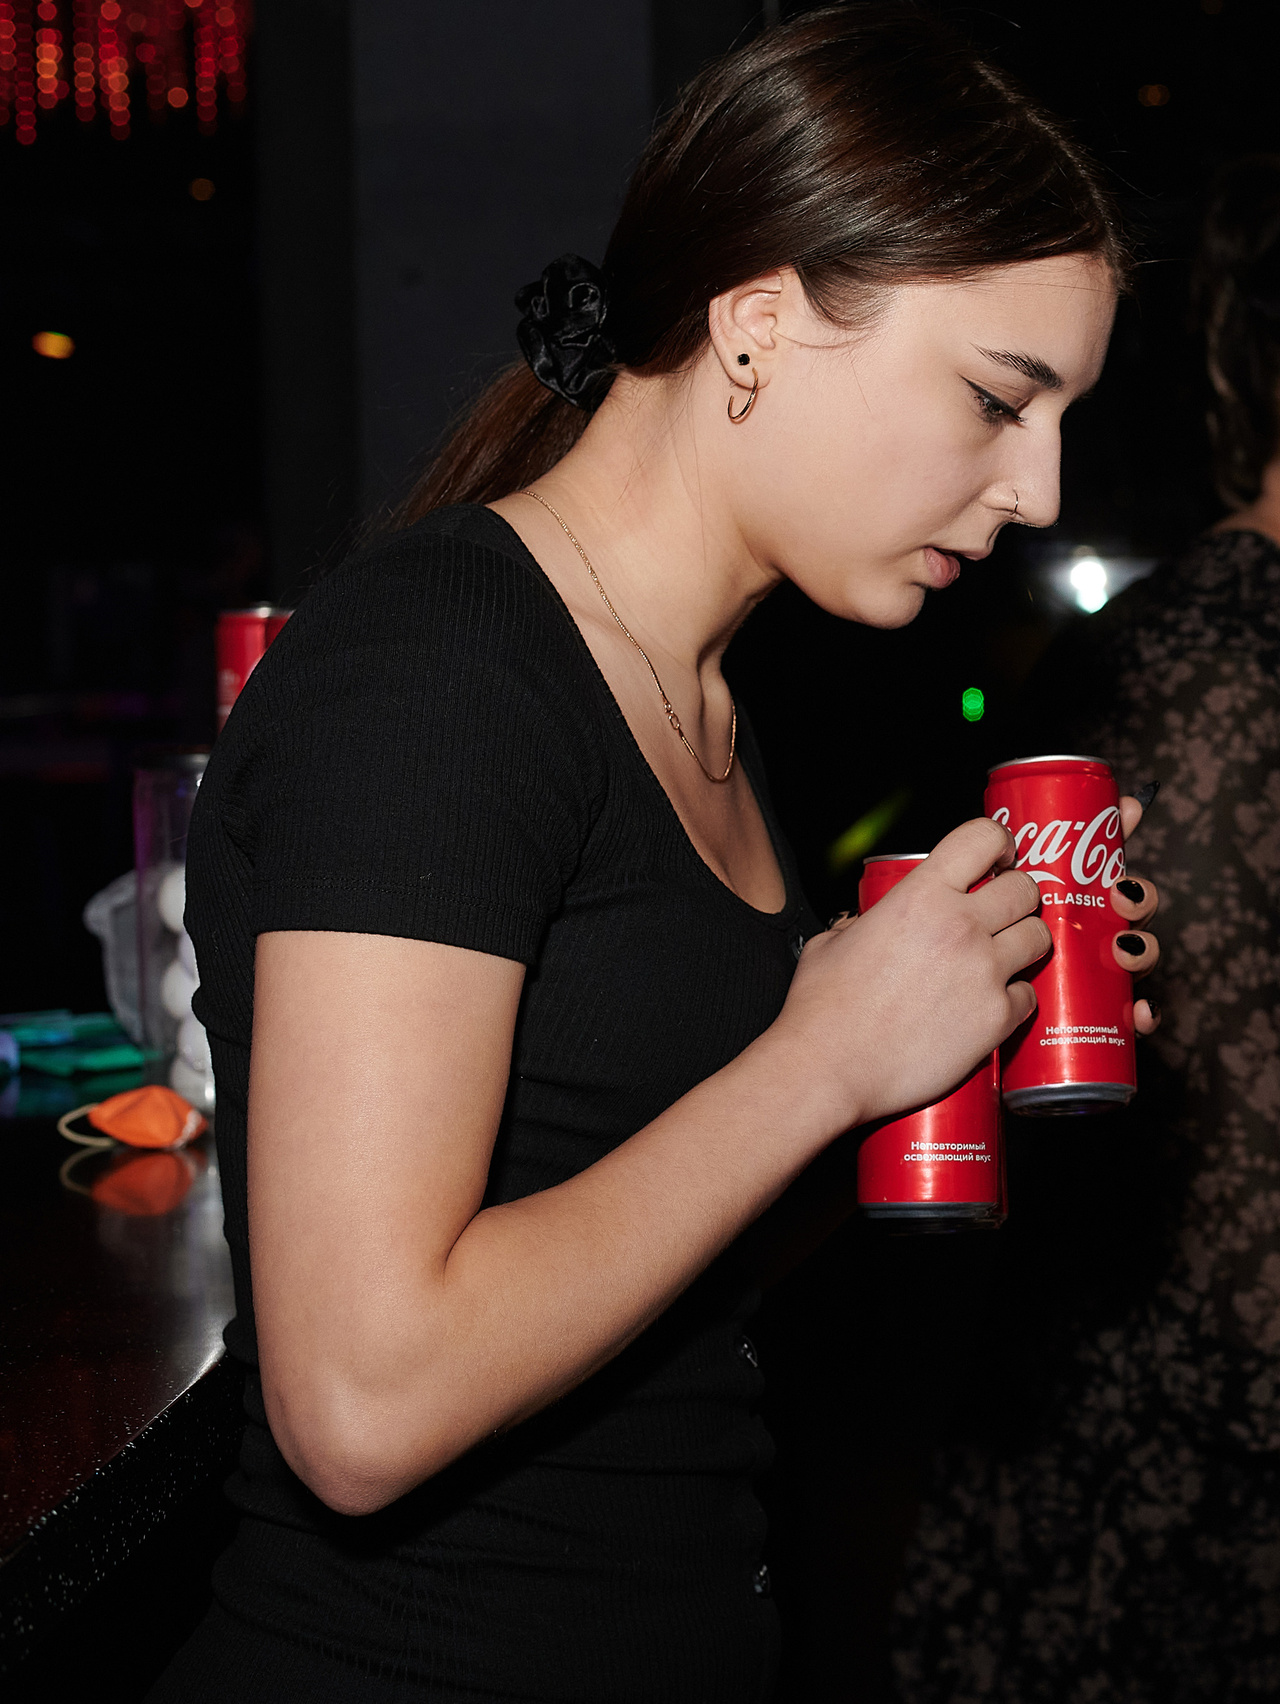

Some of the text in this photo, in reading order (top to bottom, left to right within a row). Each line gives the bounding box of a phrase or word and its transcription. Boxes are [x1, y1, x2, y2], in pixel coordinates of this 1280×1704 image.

[1041, 892, 1106, 908] CLASSIC
[1045, 1026, 1119, 1035] Неповторимый
[1039, 1035, 1126, 1047] освежающий вкус
[910, 1141, 986, 1152] Неповторимый
[903, 1152, 992, 1163] освежающий вкус
